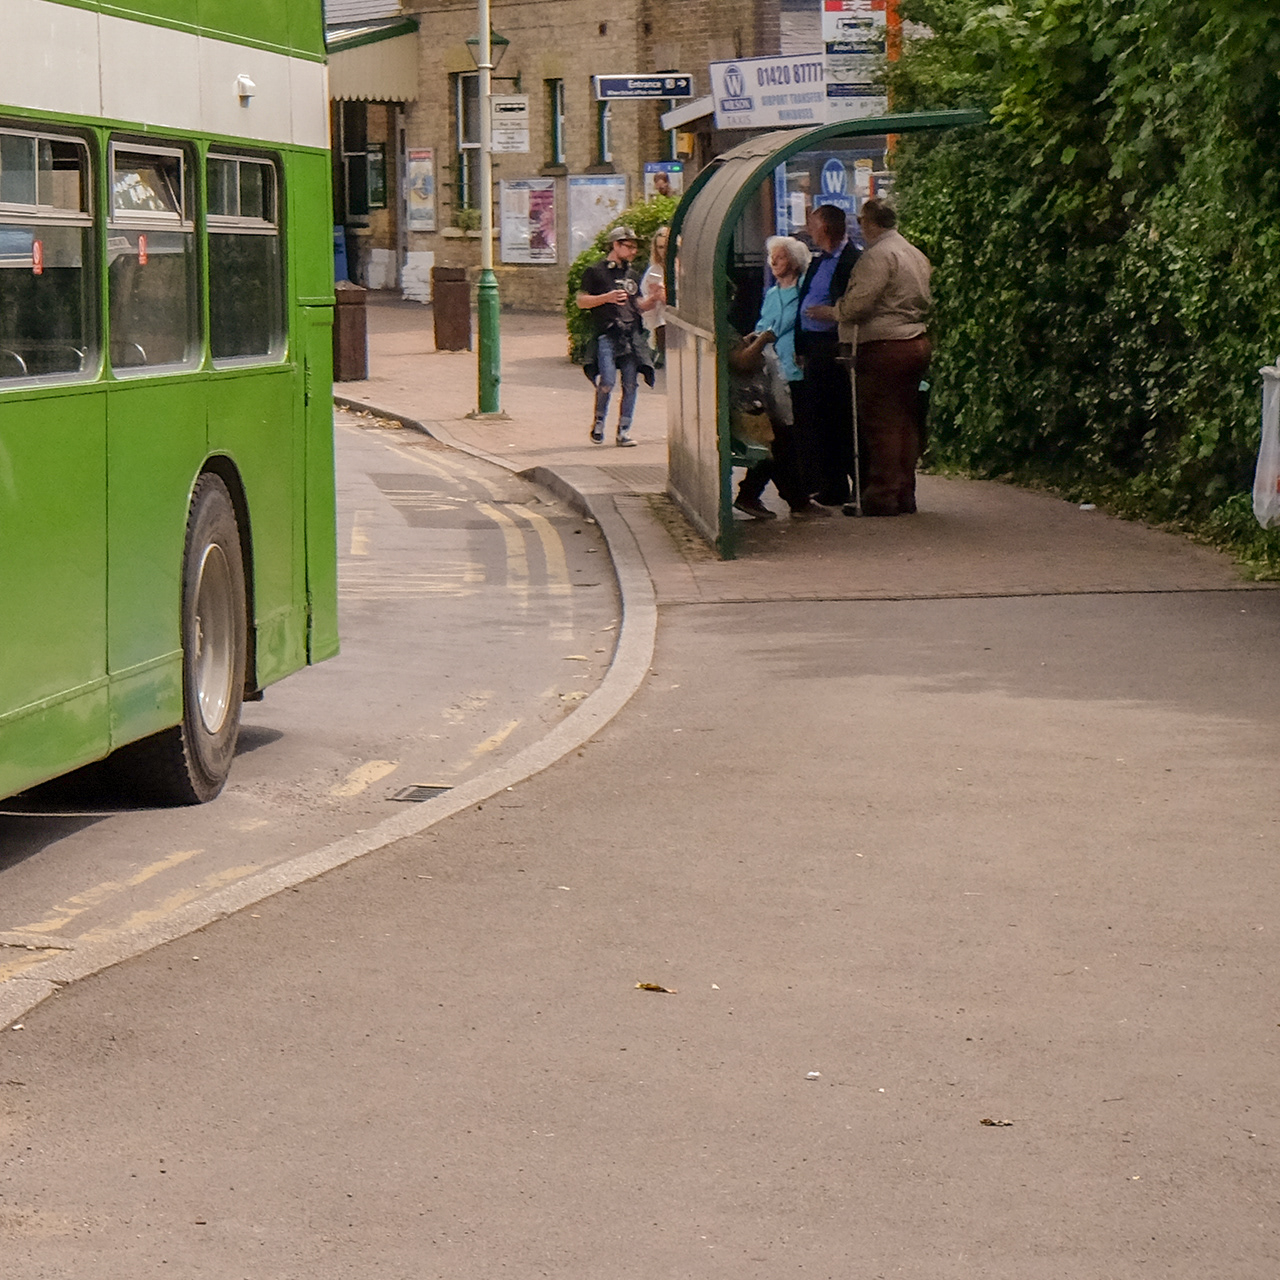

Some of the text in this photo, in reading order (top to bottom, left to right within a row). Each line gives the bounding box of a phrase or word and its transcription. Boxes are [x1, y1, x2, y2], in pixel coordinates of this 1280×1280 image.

[757, 65, 791, 87] 01420
[793, 62, 824, 84] 87777
[628, 79, 662, 89] Entrance
[727, 115, 752, 126] TAXIS
[826, 171, 842, 193] W
